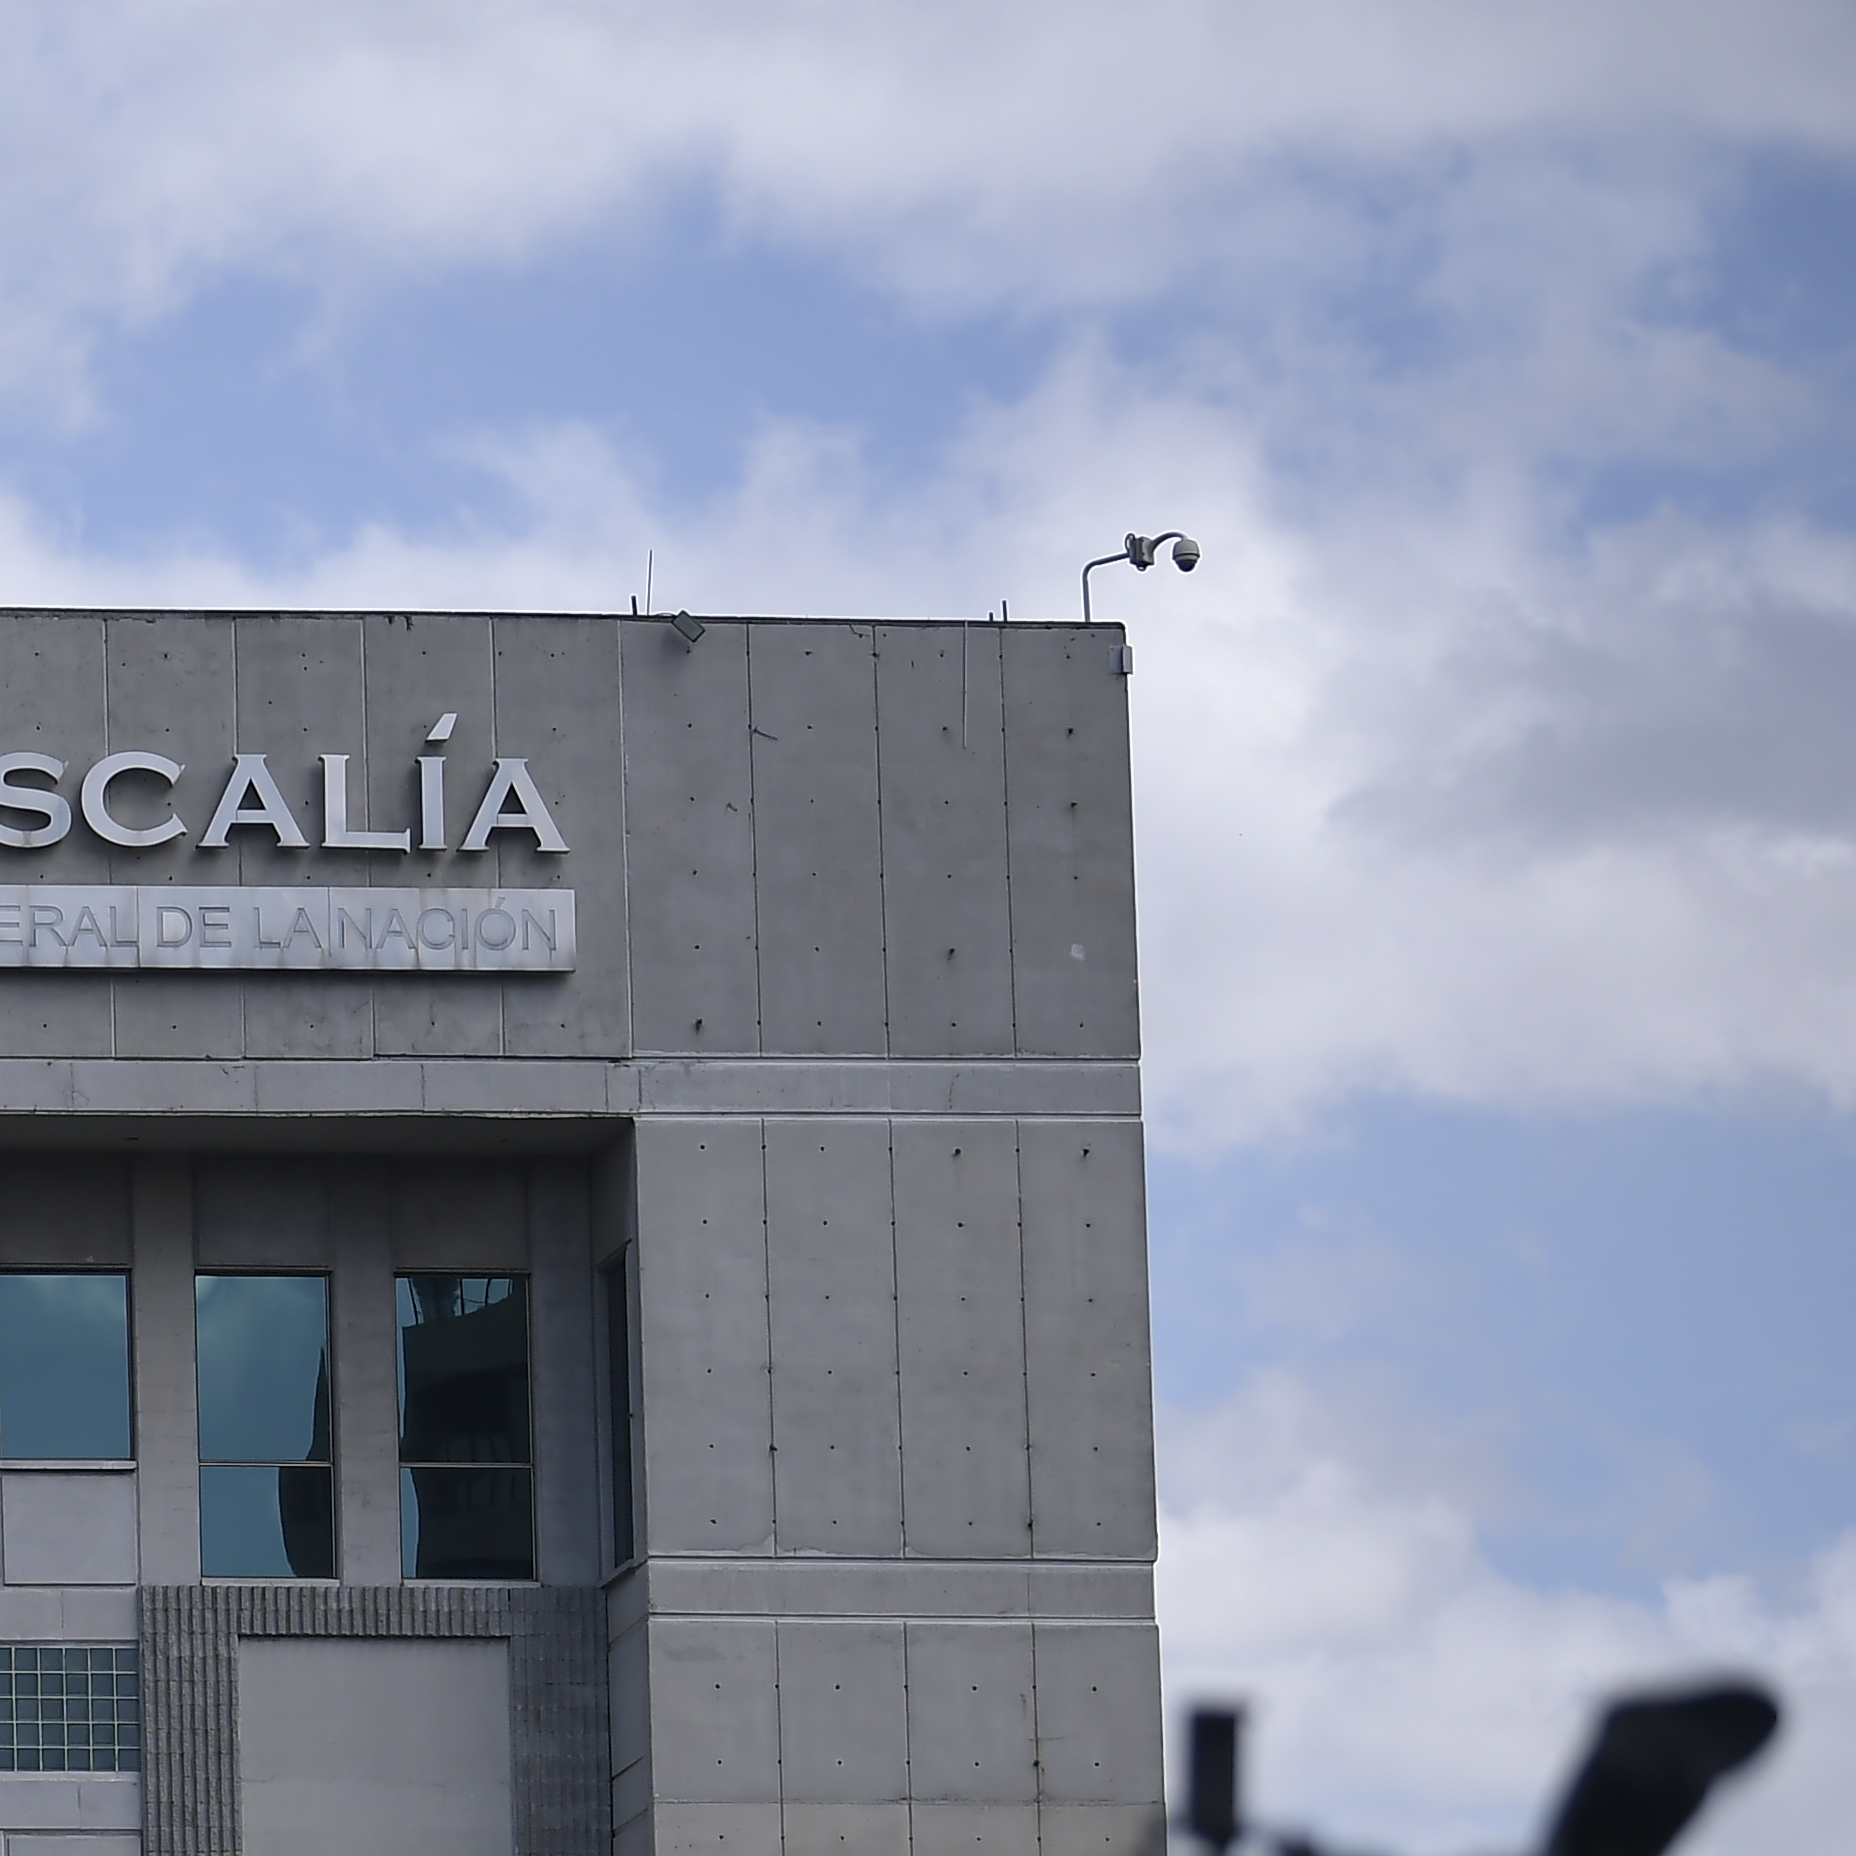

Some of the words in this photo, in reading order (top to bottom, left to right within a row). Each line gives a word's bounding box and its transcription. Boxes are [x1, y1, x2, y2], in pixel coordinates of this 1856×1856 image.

[155, 903, 233, 949] DE
[254, 904, 322, 950] LA
[336, 895, 557, 952] NACIÓN
